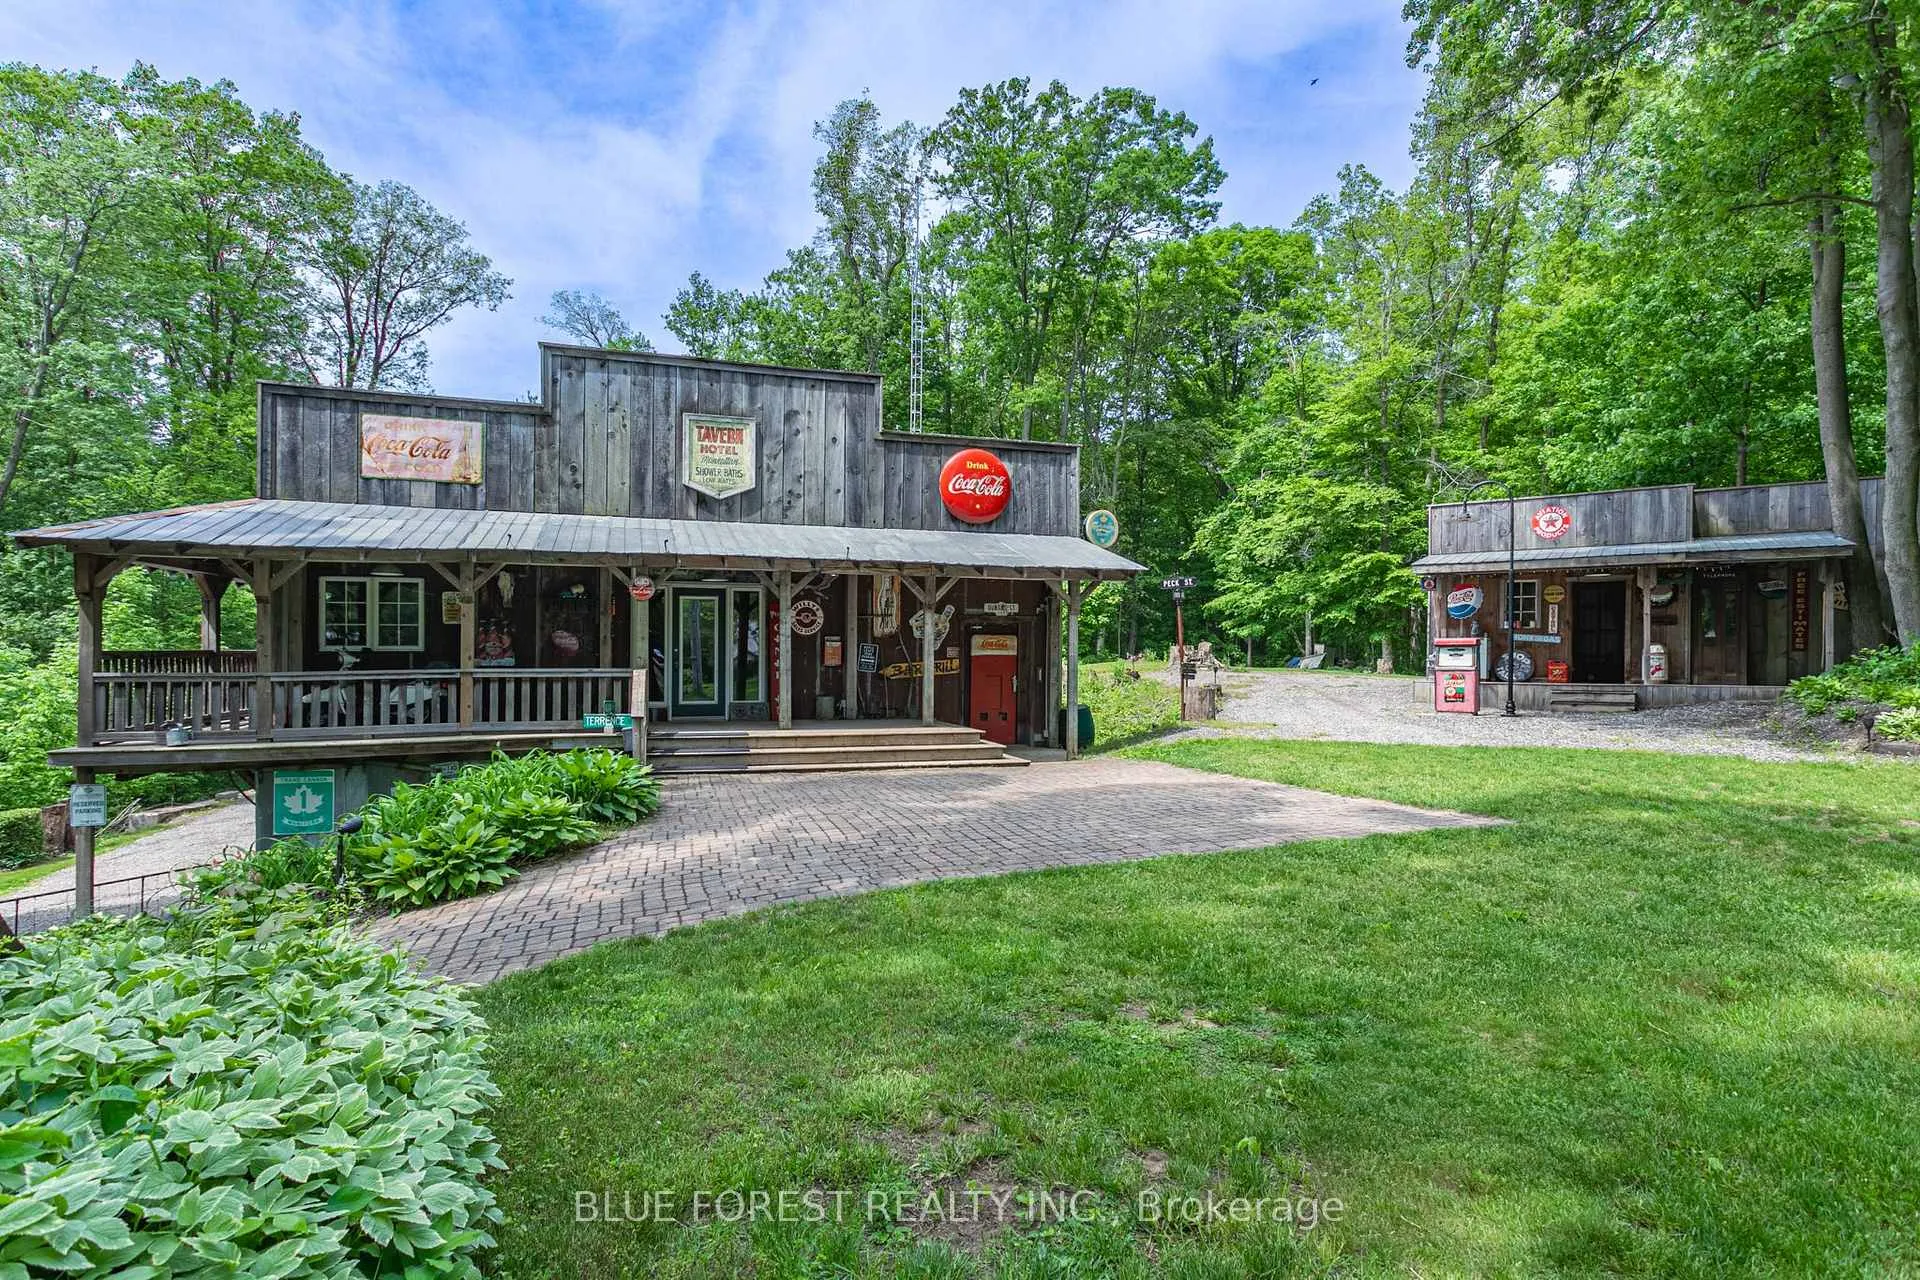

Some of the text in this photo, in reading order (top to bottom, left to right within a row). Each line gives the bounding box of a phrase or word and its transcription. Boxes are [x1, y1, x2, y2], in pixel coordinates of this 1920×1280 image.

[696, 425, 744, 445] TAVERN
[700, 444, 738, 456] HOTEL
[965, 461, 989, 470] Drink
[696, 466, 744, 479] SHOWER BATHS
[1535, 506, 1568, 519] AVIATION
[1533, 524, 1570, 539] PRODUCTS
[1163, 580, 1180, 588] PECK
[1793, 598, 1808, 649] ESTIMATES
[586, 716, 625, 727] TERRENCE
[300, 790, 307, 809] 1
